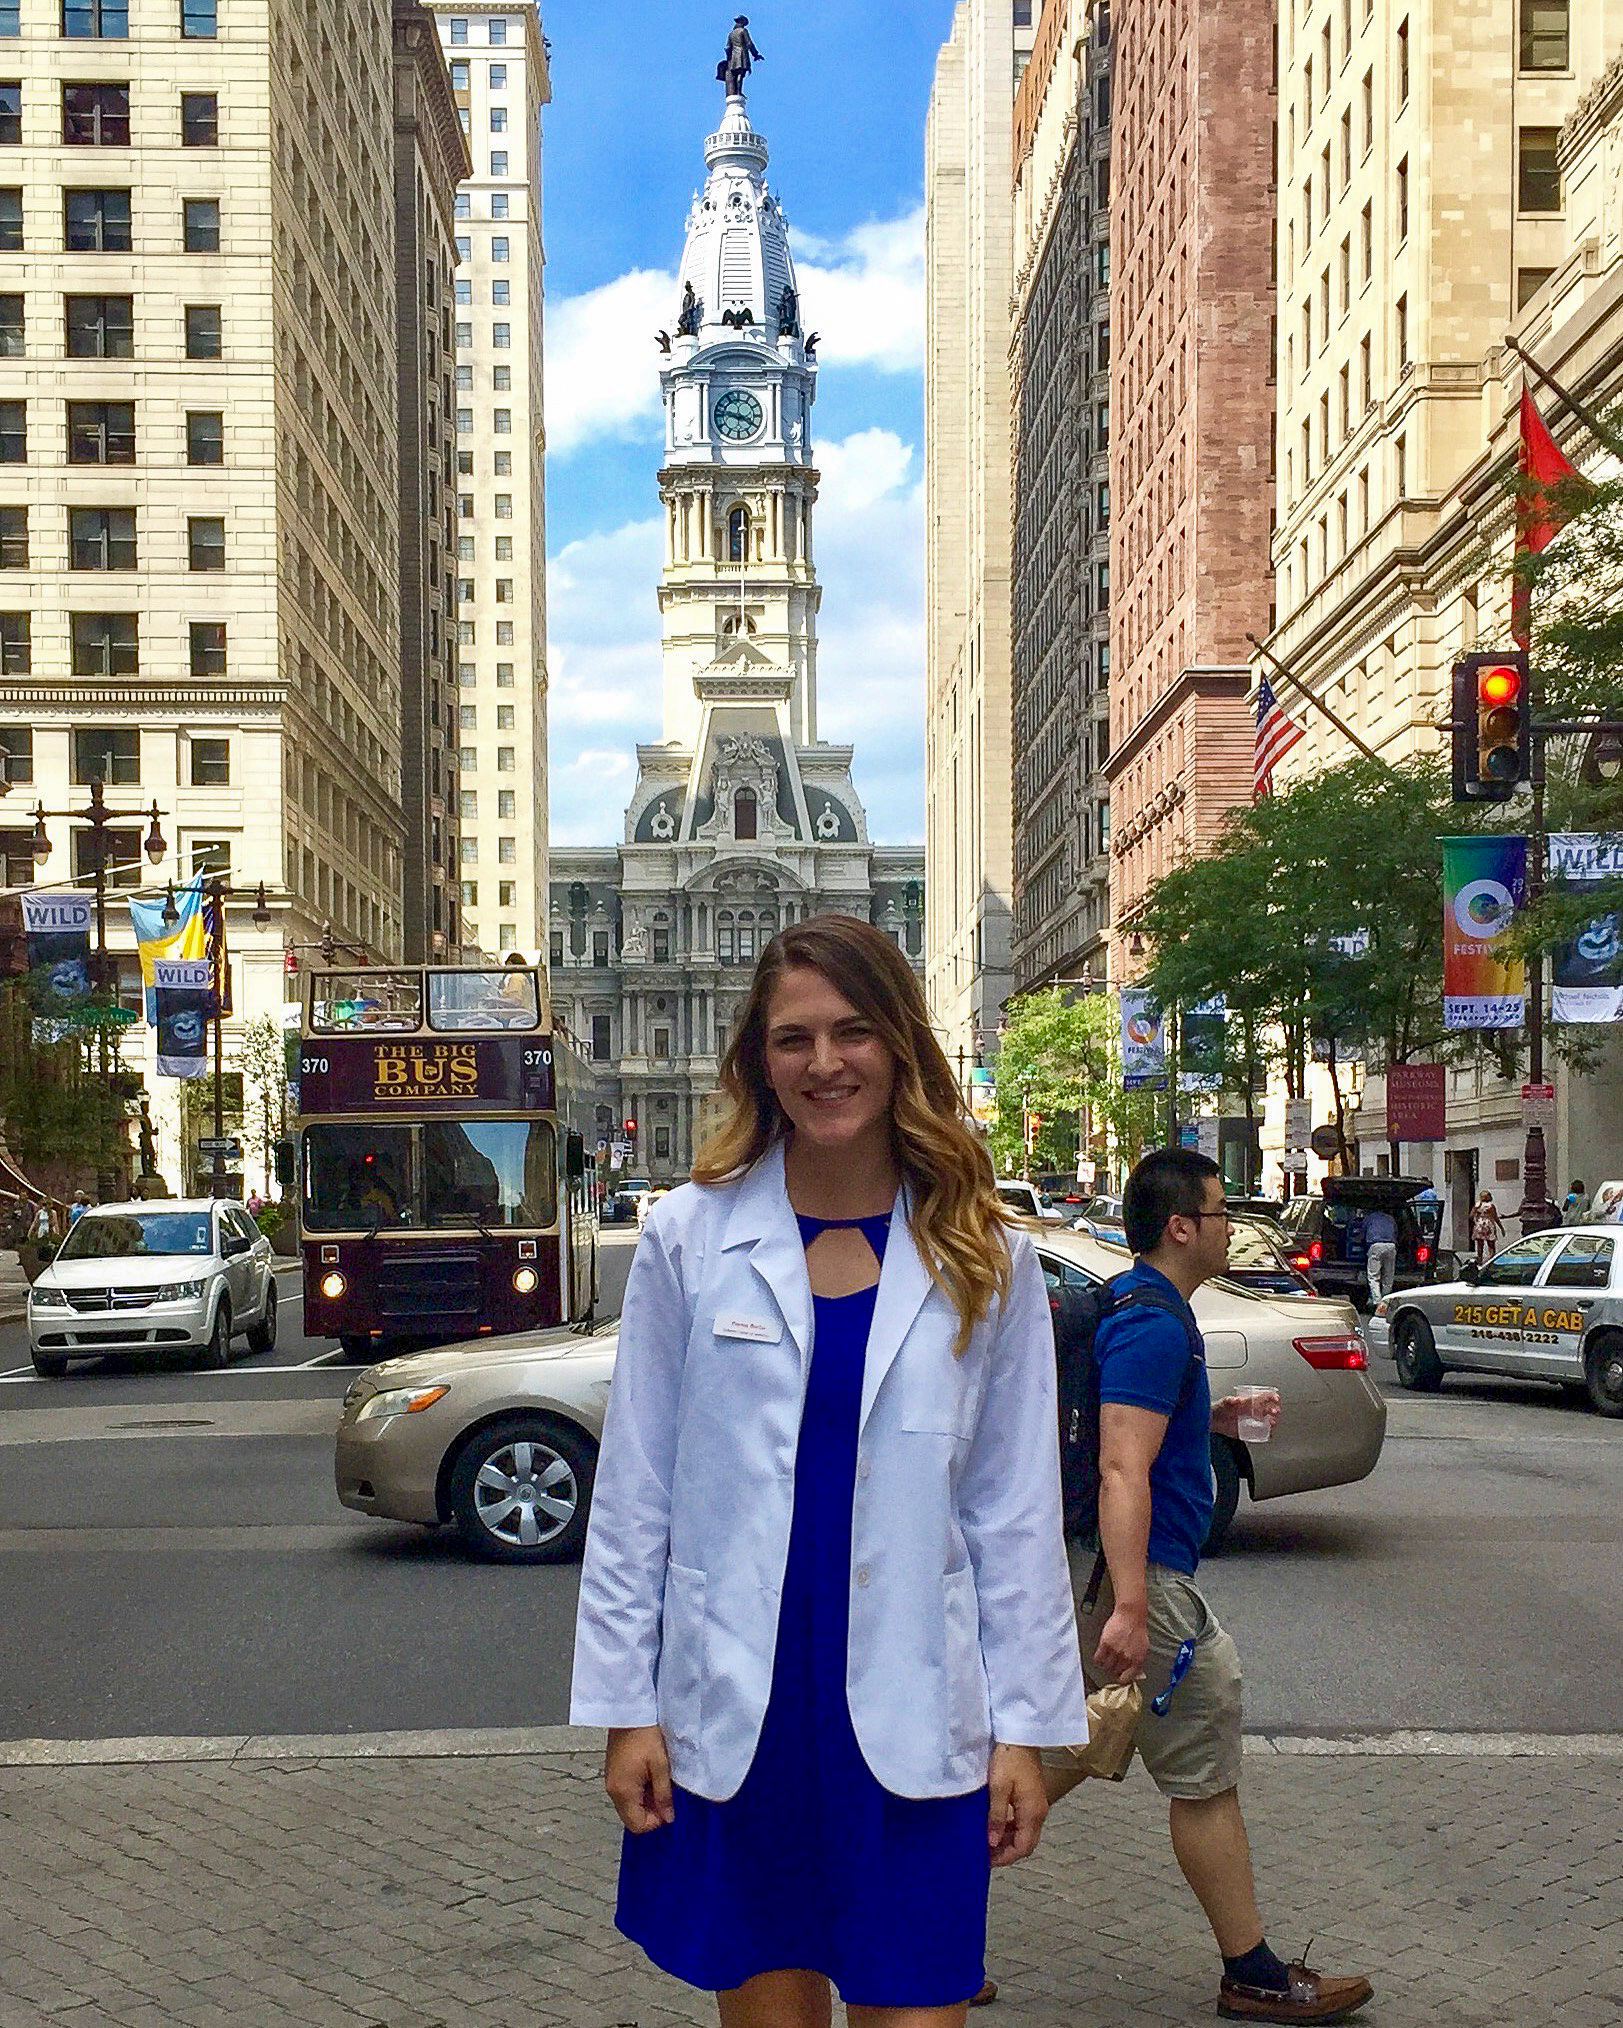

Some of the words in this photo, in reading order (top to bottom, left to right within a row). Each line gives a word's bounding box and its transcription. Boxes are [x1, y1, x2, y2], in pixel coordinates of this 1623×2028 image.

[26, 907, 88, 924] WILD
[157, 968, 206, 983] WILD
[1449, 1004, 1478, 1014] SEPT.
[1484, 1003, 1520, 1013] 14-25
[374, 1044, 424, 1058] THE
[434, 1044, 476, 1058] BIG
[524, 1050, 552, 1065] 370
[302, 1058, 329, 1073] 370
[374, 1057, 478, 1084] BUS
[374, 1084, 477, 1096] COMPANY
[1454, 1305, 1482, 1324] 215
[1485, 1305, 1523, 1325] GET
[1524, 1307, 1537, 1326] A
[1543, 1309, 1585, 1331] CAB
